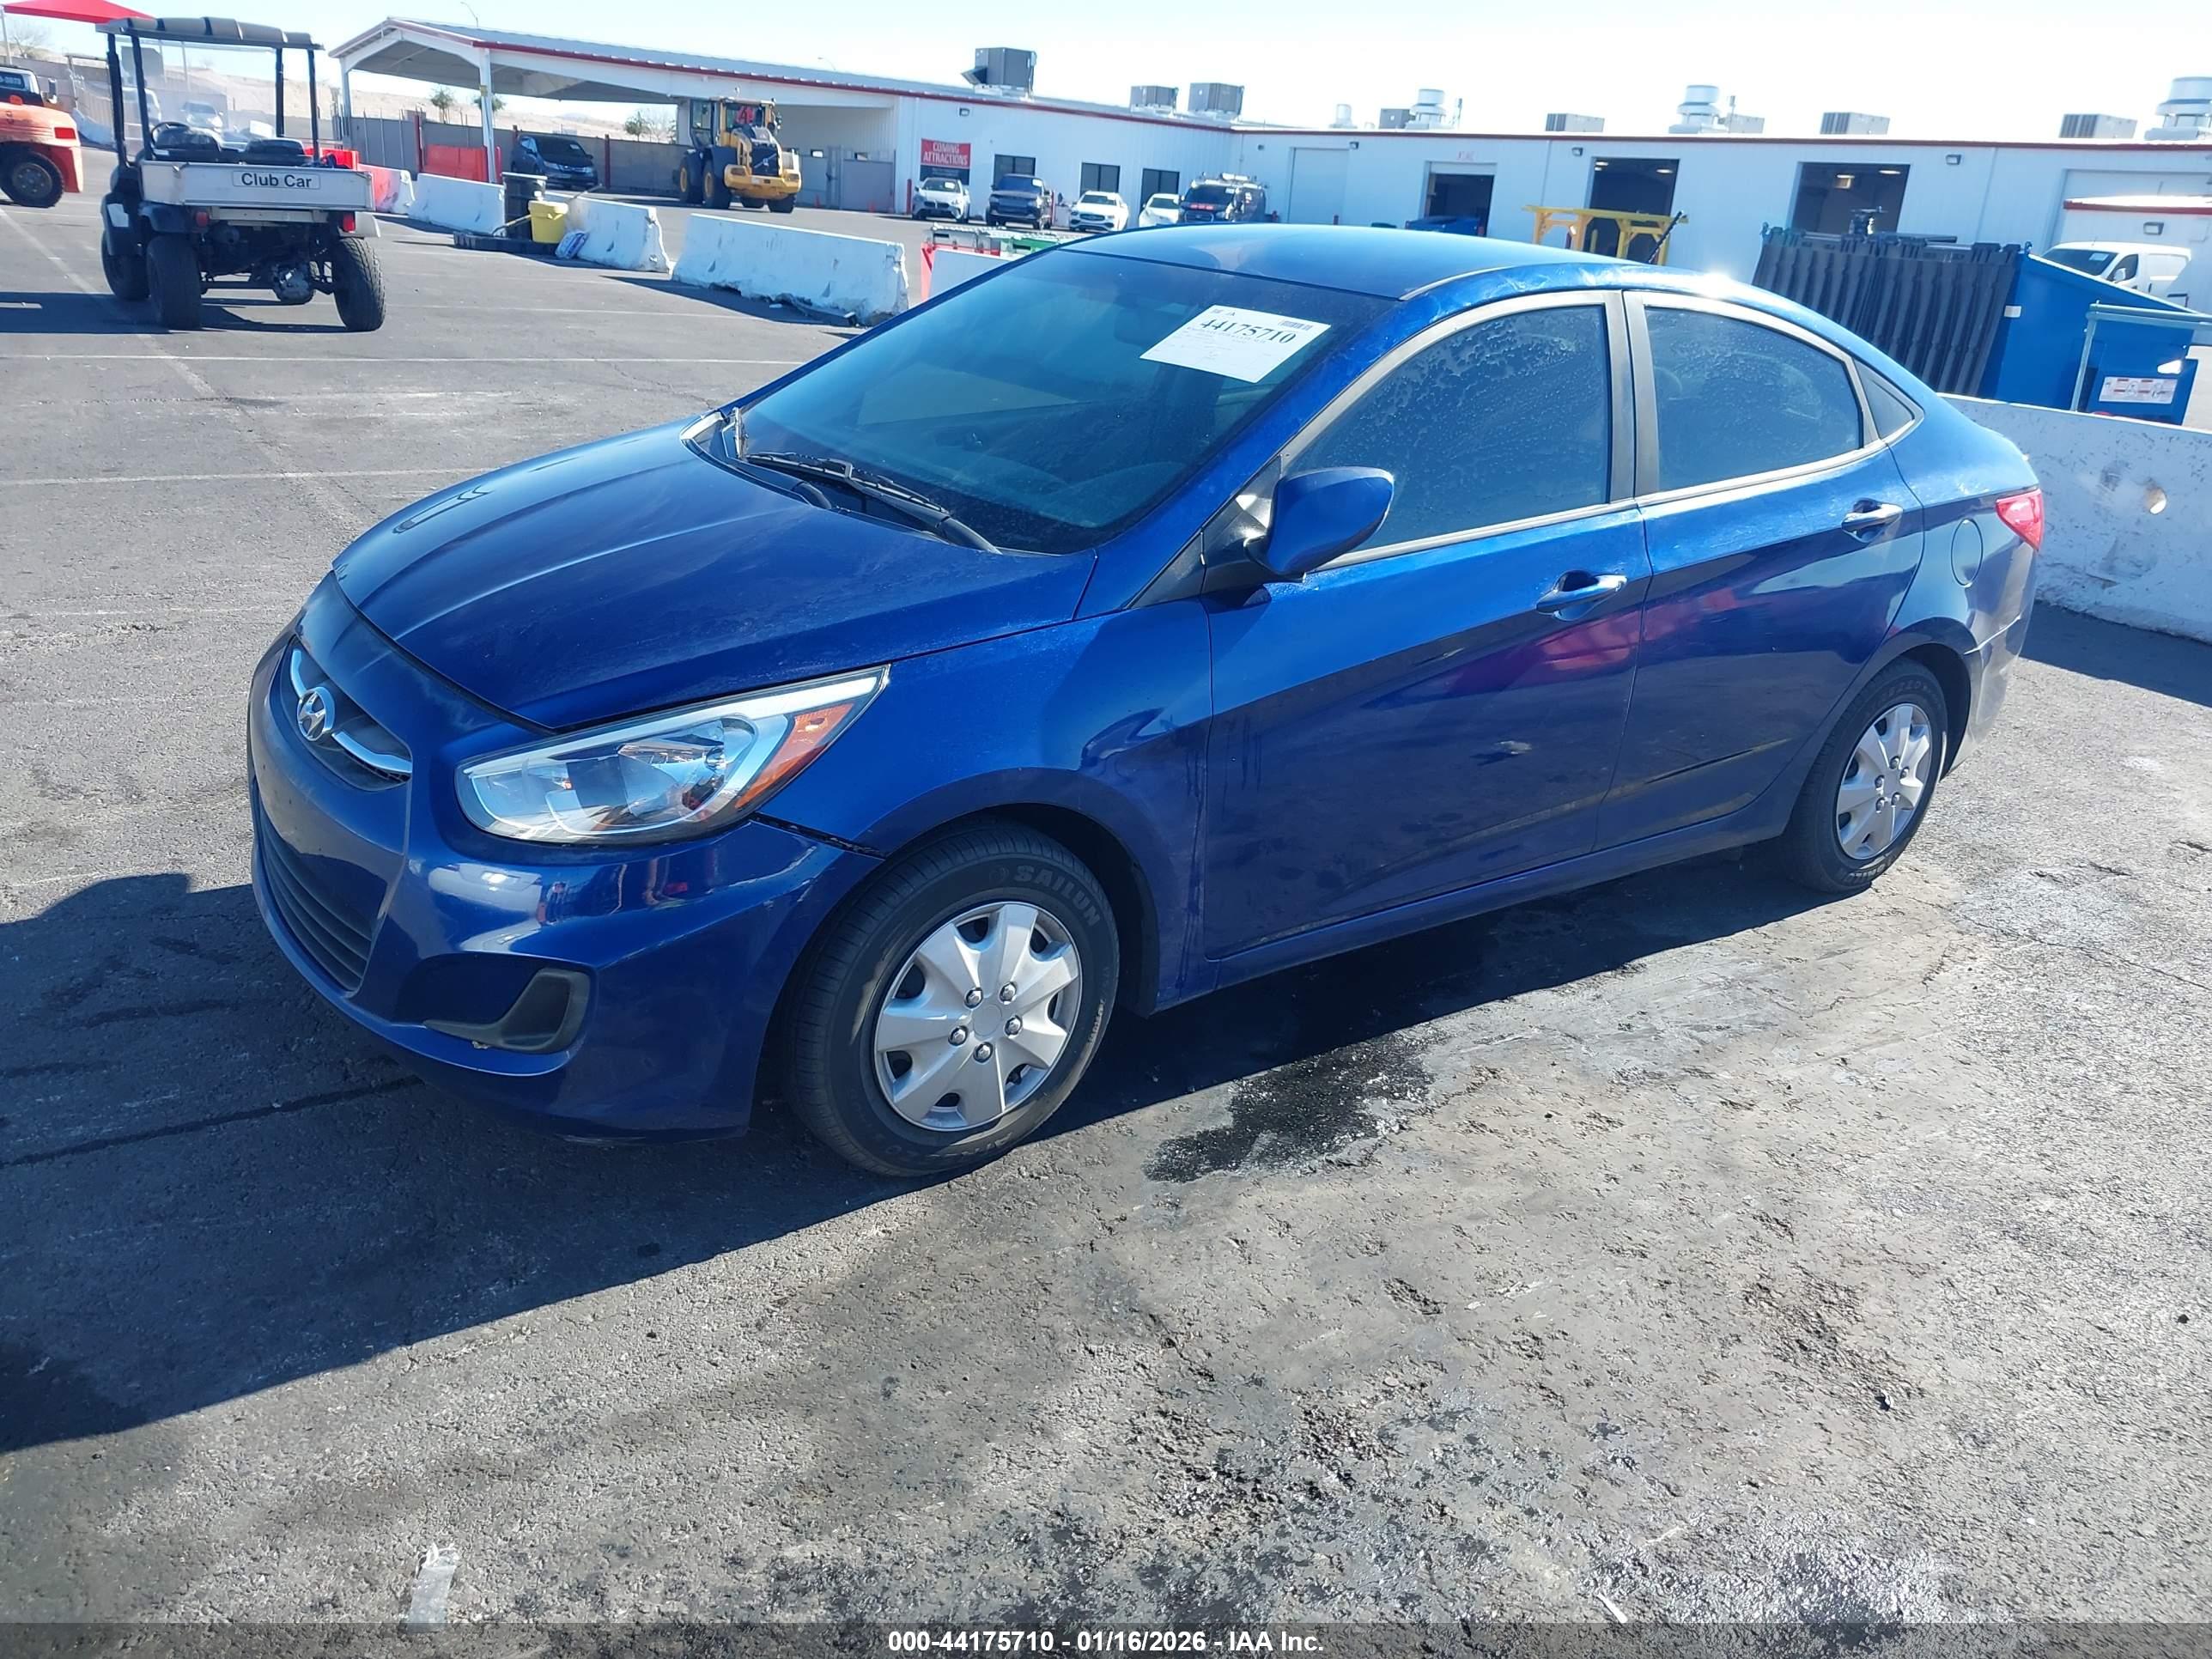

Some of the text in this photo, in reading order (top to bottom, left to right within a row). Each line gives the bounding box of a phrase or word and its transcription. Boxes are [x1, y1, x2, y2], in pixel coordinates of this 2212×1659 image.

[933, 142, 960, 154] COMING
[923, 151, 968, 166] ATTRACTIONS
[241, 173, 312, 187] Club Car
[1201, 319, 1297, 344] 44175710
[1013, 865, 1100, 927] SAILUN
